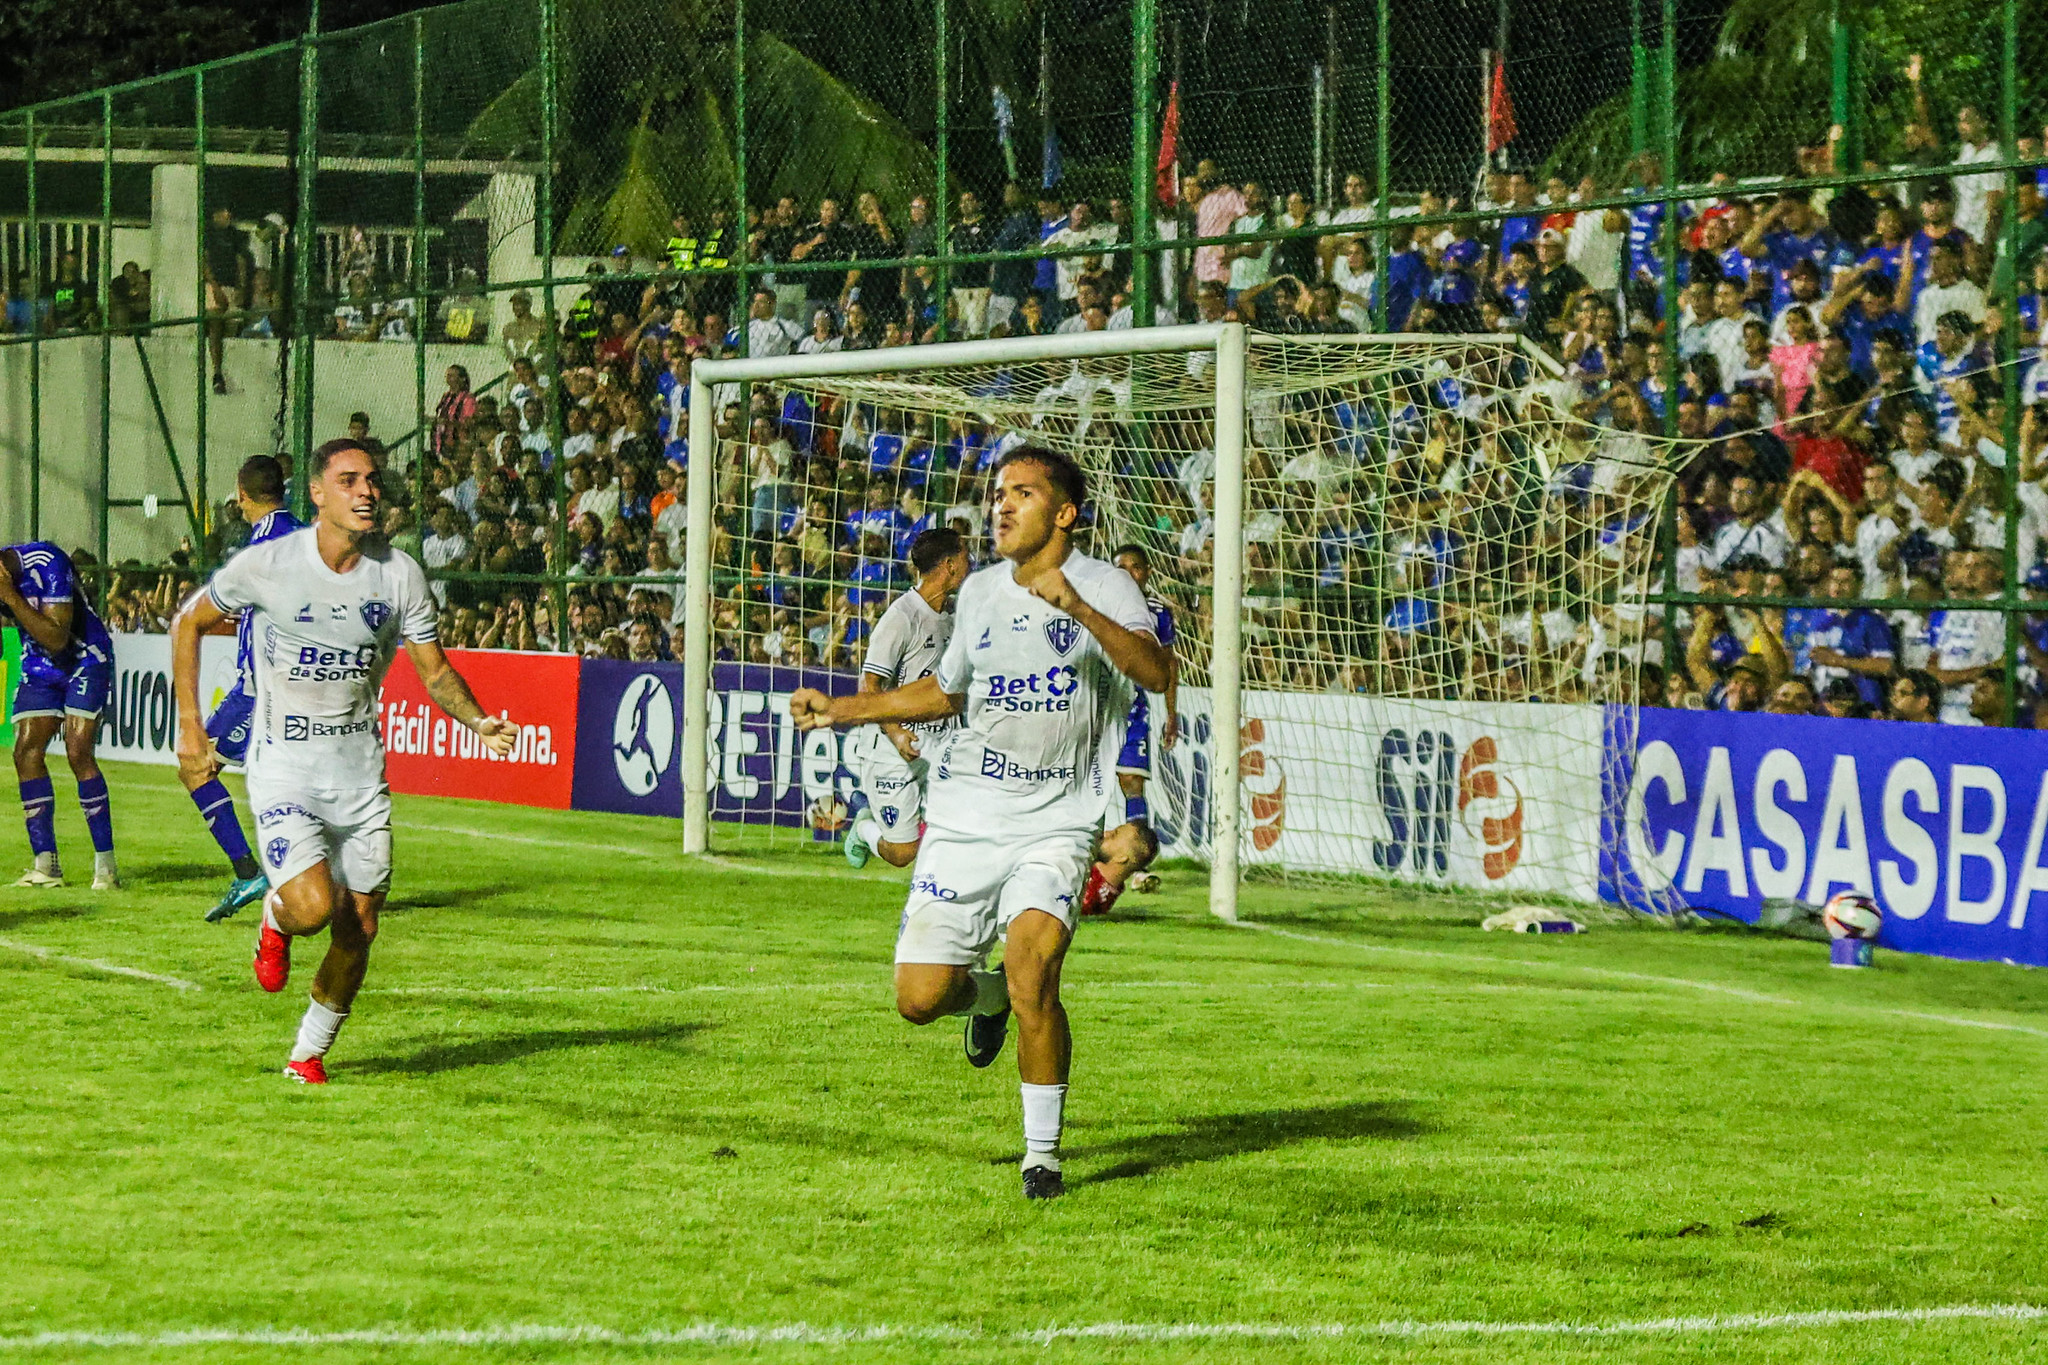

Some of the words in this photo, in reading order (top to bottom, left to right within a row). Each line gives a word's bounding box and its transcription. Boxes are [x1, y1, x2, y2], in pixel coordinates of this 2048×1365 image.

[298, 646, 351, 666] Bet
[988, 673, 1041, 697] Bet
[96, 668, 176, 752] Auro
[1004, 696, 1070, 712] Sorte
[387, 700, 430, 755] fácil
[433, 718, 447, 757] e
